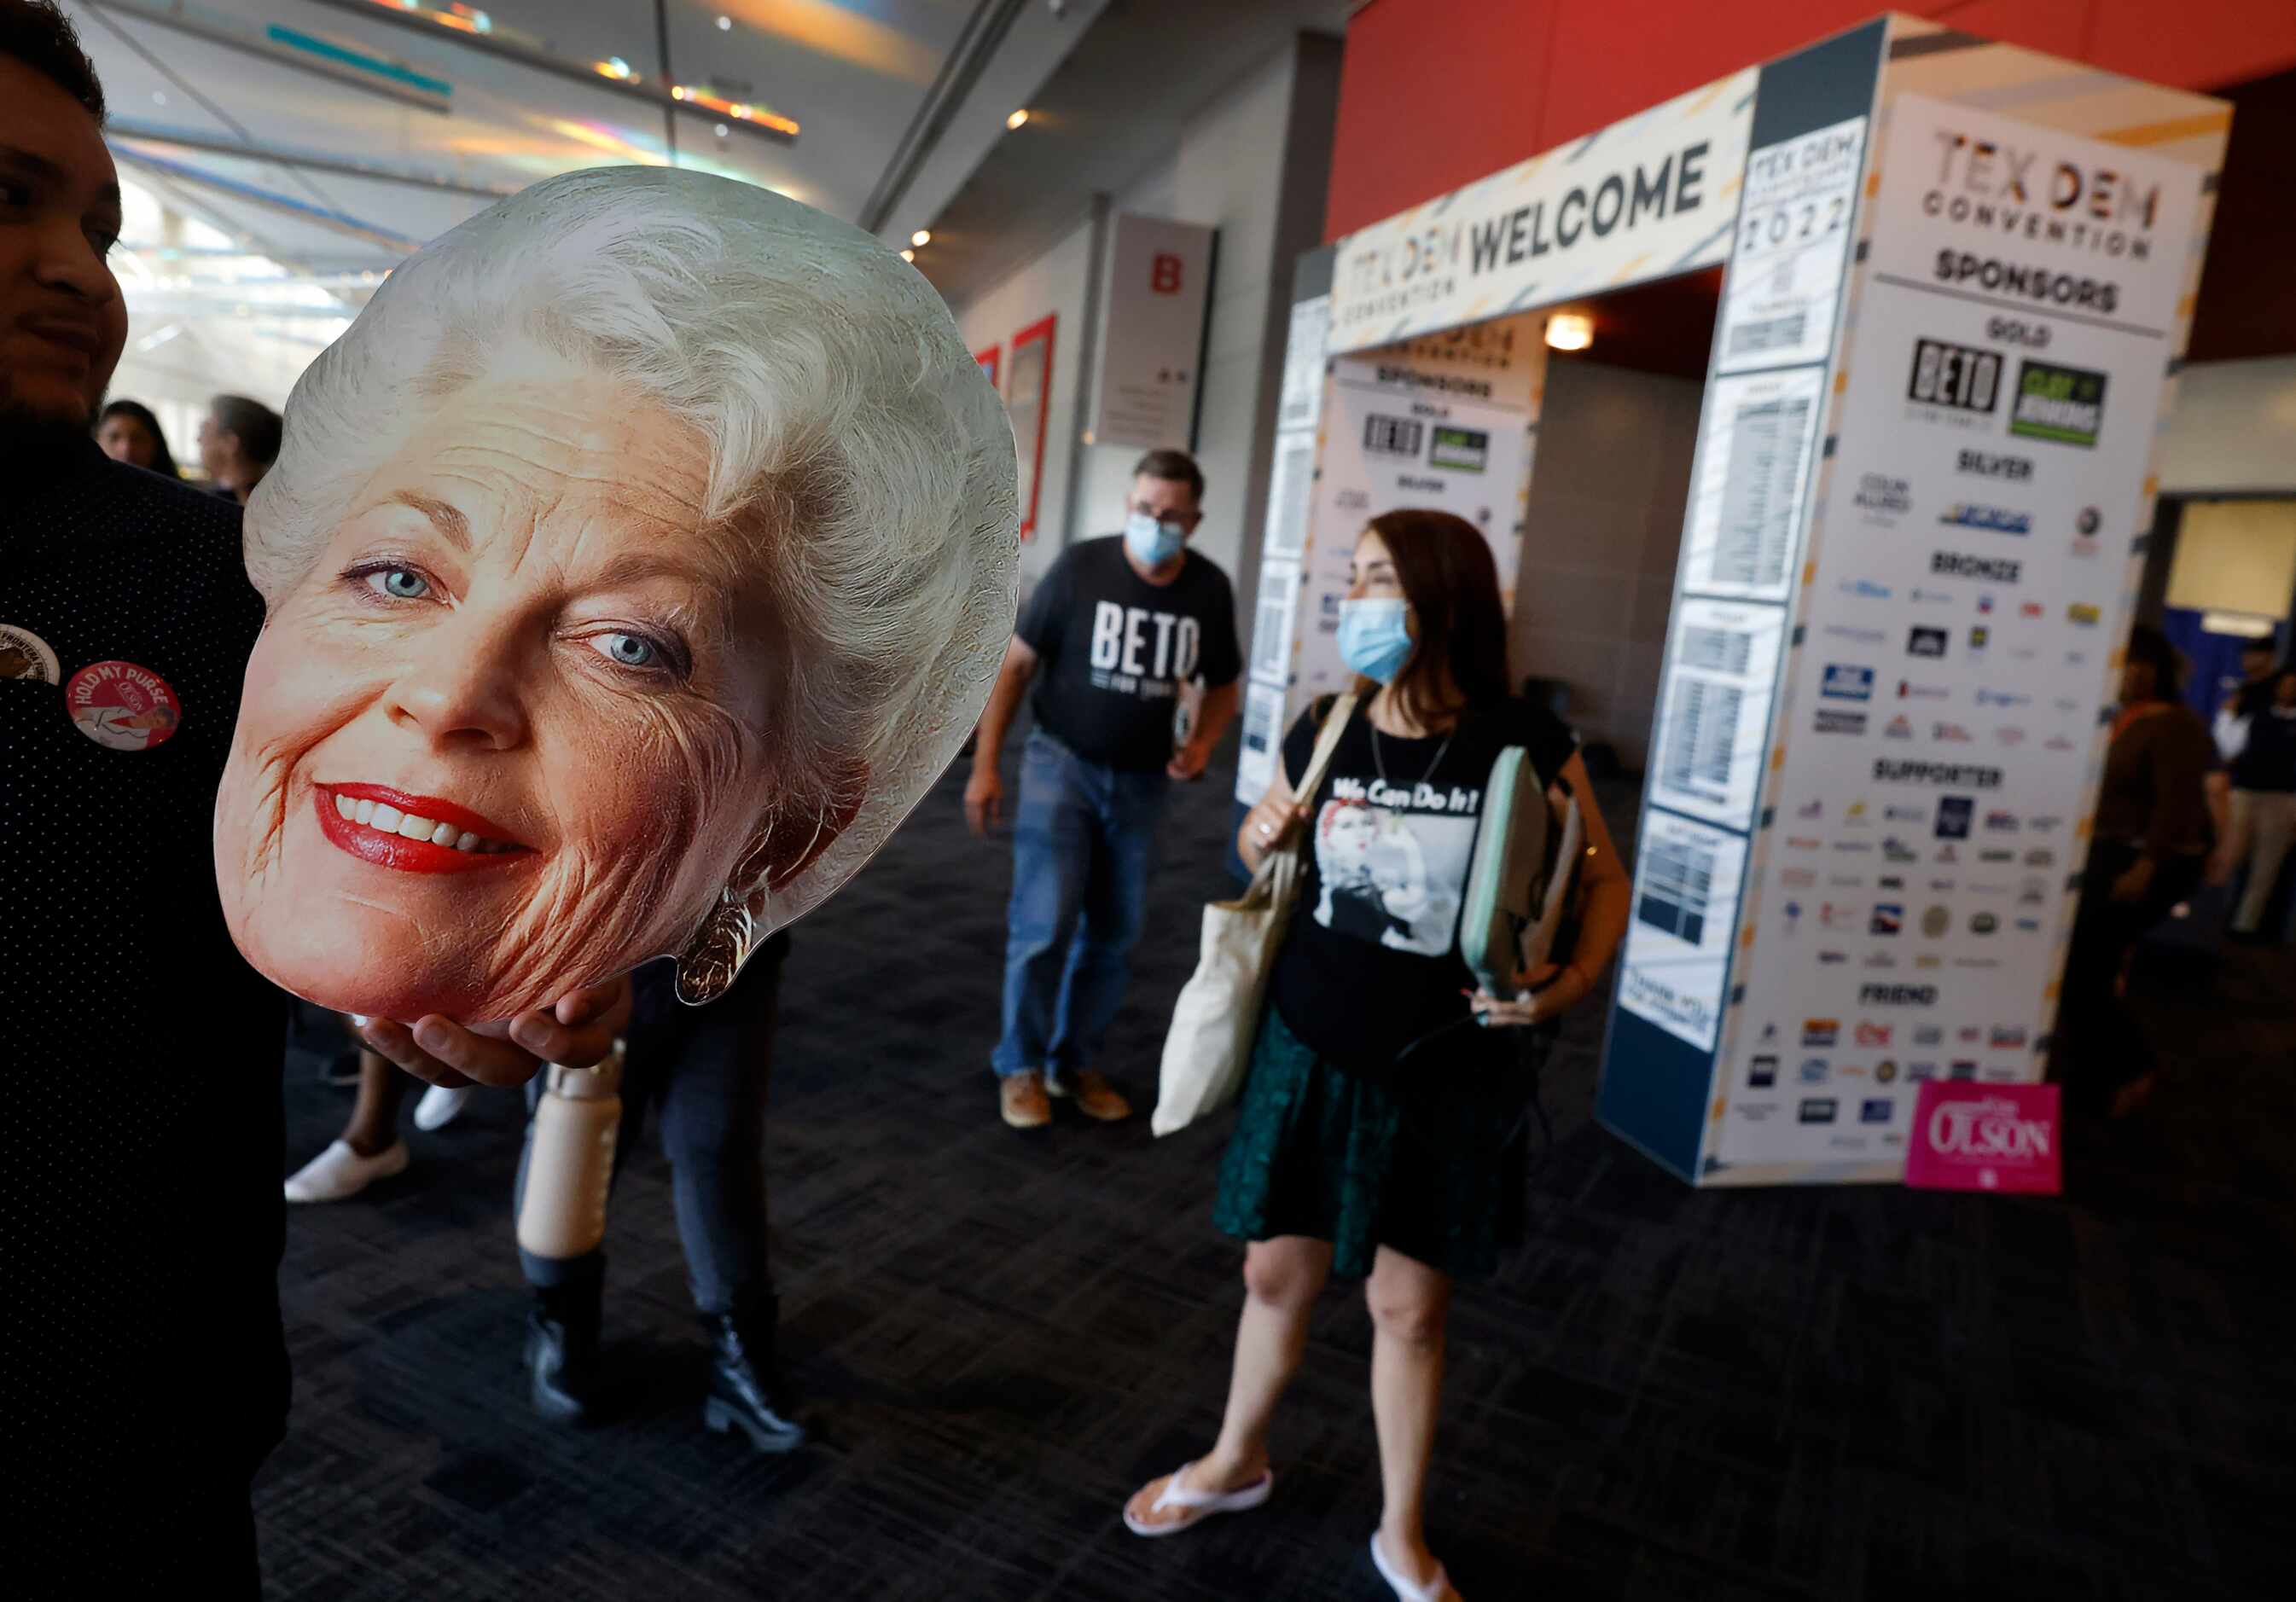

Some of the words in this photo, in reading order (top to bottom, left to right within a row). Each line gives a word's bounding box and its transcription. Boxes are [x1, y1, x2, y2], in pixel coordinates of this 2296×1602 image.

[1935, 131, 2037, 205] TEX
[2052, 162, 2159, 230] DEM
[1472, 139, 1709, 276] WELCOME
[1744, 197, 1844, 249] 2022
[1922, 189, 2150, 259] CONVENTION
[1151, 253, 1183, 293] B
[1935, 250, 2118, 313] SPONSORS
[1987, 316, 2051, 348] GOLD
[1915, 343, 1997, 410] BETO
[1956, 448, 2034, 483] SILVER
[1931, 552, 2020, 583] BRONZE
[1091, 600, 1200, 679] BETO
[74, 671, 101, 705] HOLD
[97, 665, 121, 681] MY
[125, 668, 168, 704] PURSE
[1334, 777, 1365, 799] We
[1368, 778, 1410, 807] Can
[1412, 782, 1447, 810] Do
[1449, 786, 1479, 813] It!
[1873, 758, 2004, 789] SUPPORTER
[1860, 982, 1939, 1007] FRIEND
[1929, 1100, 2050, 1158] OLSON
